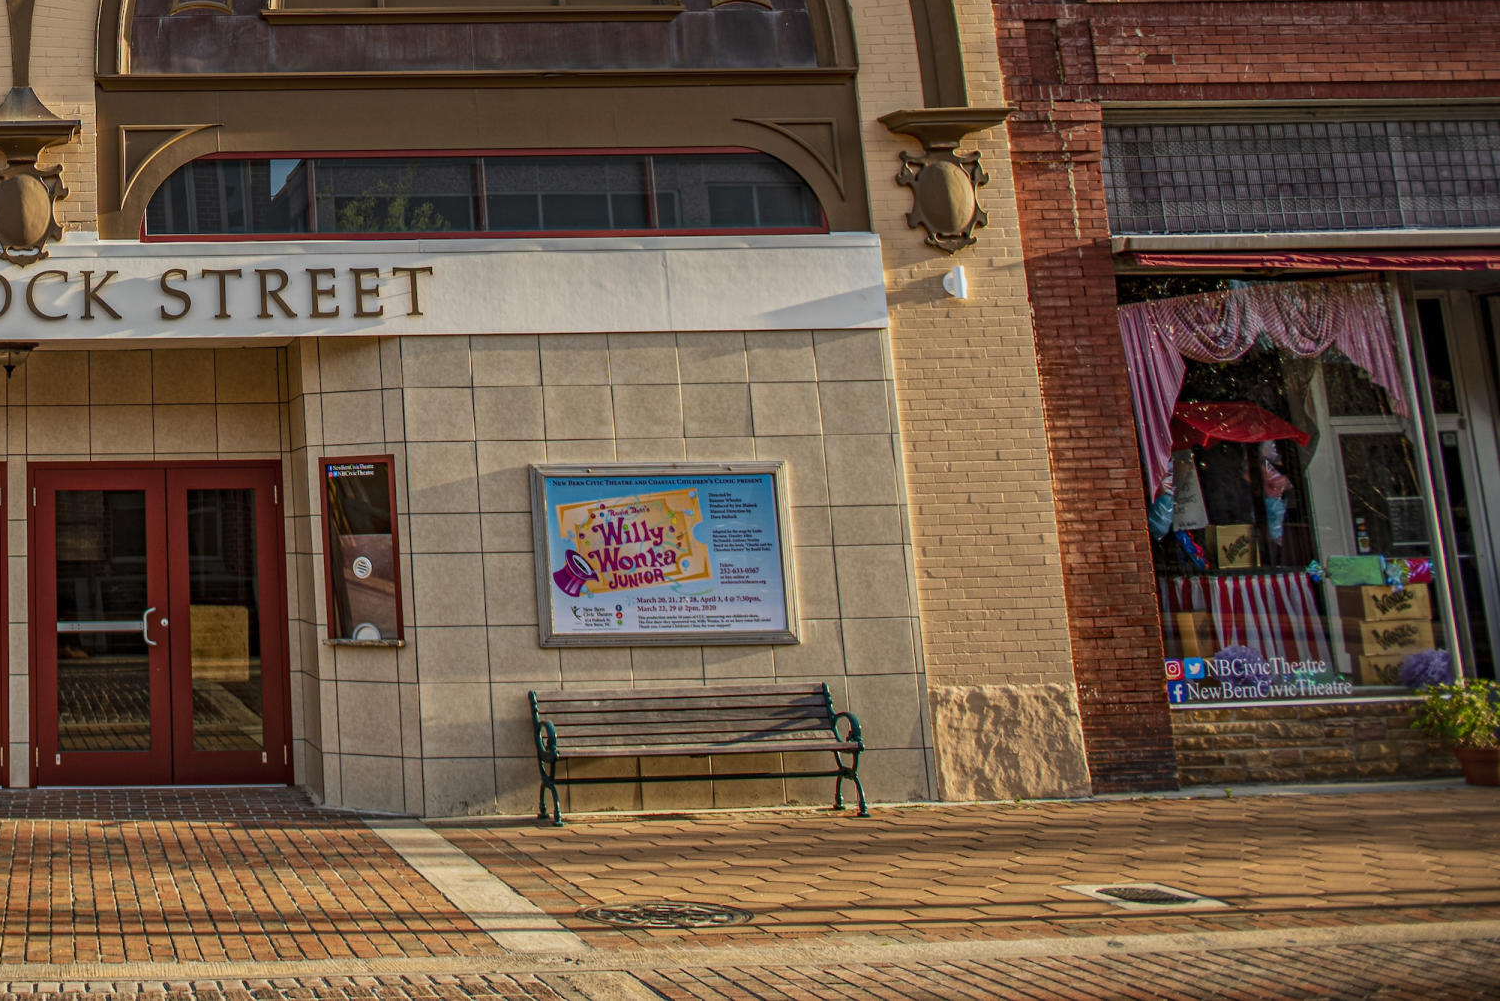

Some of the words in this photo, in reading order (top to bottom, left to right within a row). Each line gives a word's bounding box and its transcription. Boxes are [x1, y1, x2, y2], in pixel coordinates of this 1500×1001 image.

[159, 265, 435, 322] STREET
[592, 517, 665, 546] Willy
[588, 546, 677, 572] Wonka
[608, 568, 665, 590] JUNIOR
[1204, 657, 1327, 678] NBCivicTheatre
[1186, 680, 1353, 701] NewBernCivicTheatre
